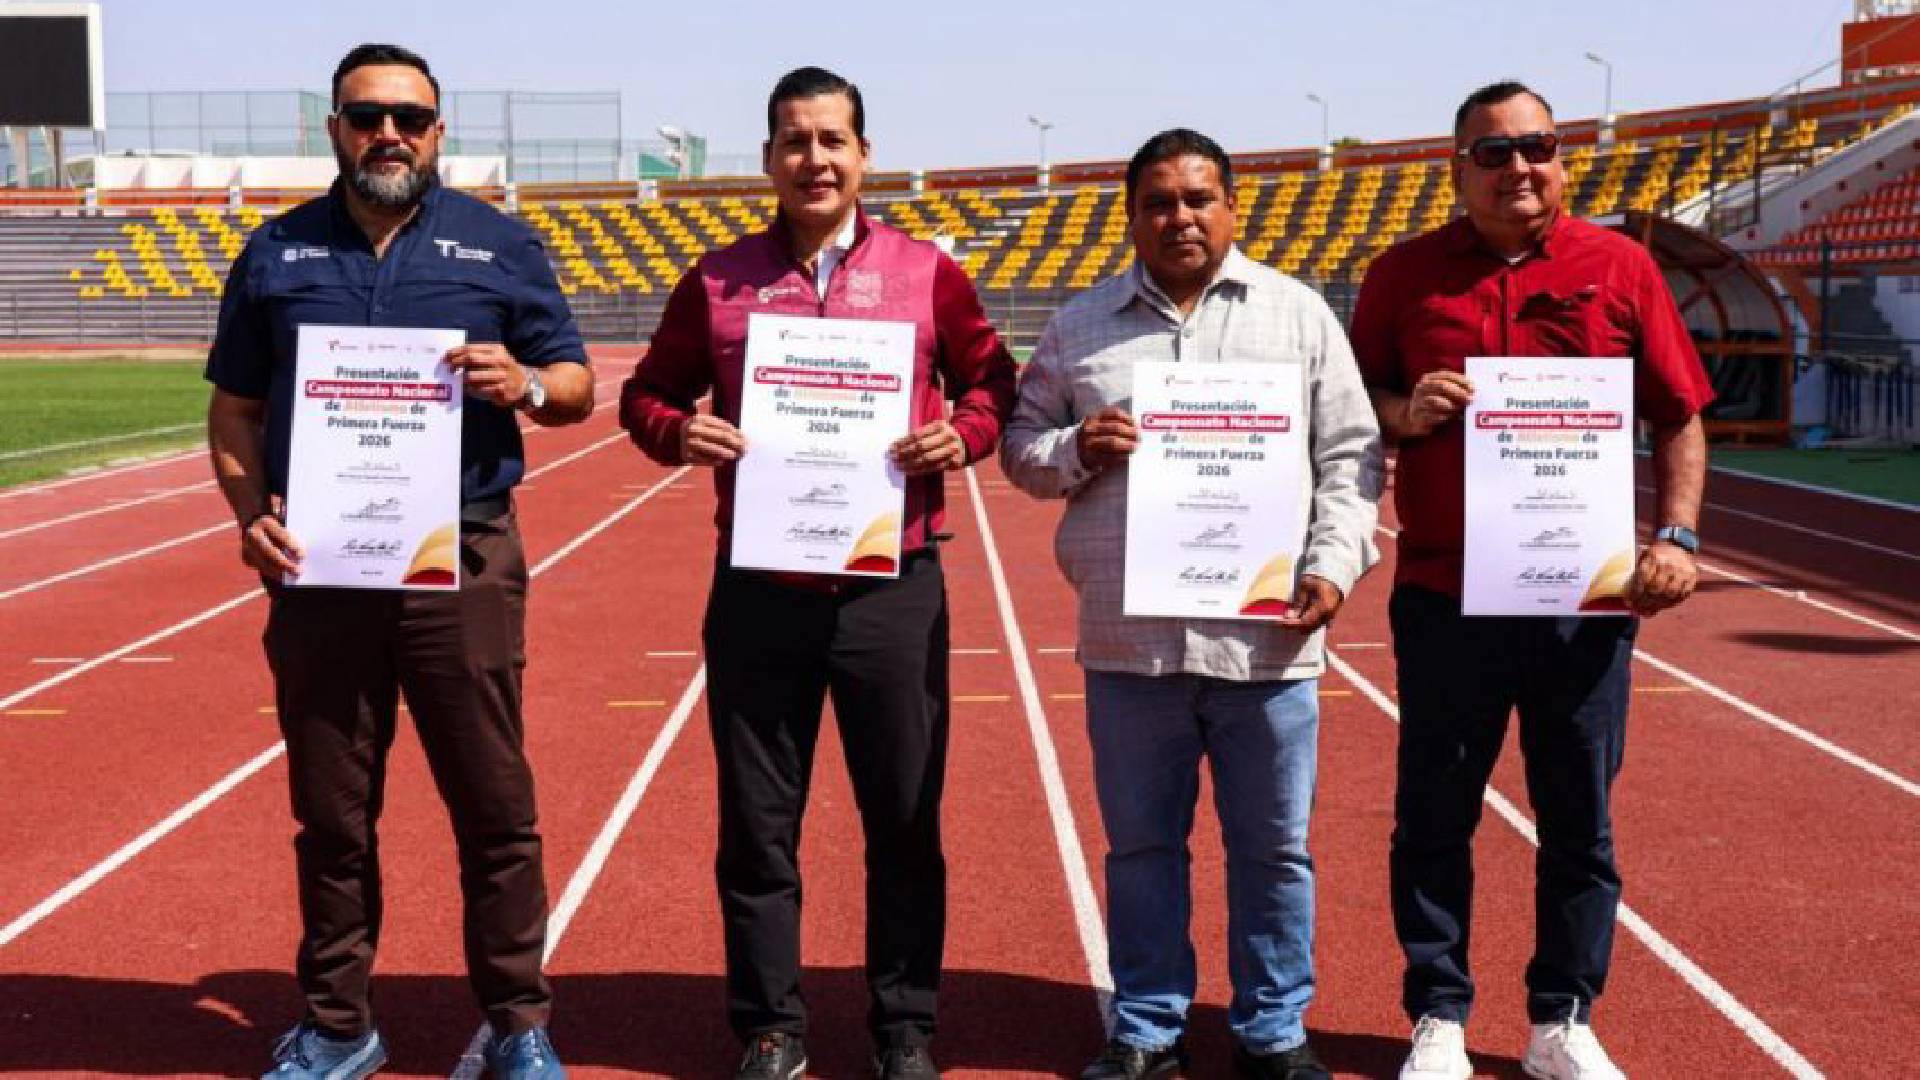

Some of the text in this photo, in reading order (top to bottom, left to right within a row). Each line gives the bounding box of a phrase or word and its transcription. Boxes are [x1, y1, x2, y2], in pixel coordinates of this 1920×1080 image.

[785, 355, 871, 369] Presentación
[335, 366, 420, 380] Presentación
[758, 369, 897, 388] Campeonato Nacional
[310, 382, 449, 398] Campeonato Nacional
[774, 385, 791, 398] de
[860, 390, 876, 404] de
[324, 400, 341, 412] de
[410, 402, 427, 414] de
[1171, 400, 1257, 412] Presentación
[1505, 397, 1590, 409] Presentación
[776, 402, 875, 420] Primera Fuerza
[327, 416, 426, 432] Primera Fuerza
[807, 420, 840, 434] 2026
[1145, 416, 1287, 431] Campeonato Nacional
[1479, 413, 1619, 430] Campeonato Nacional
[358, 434, 391, 448] 2026
[1161, 431, 1178, 443] de
[1249, 432, 1265, 444] de
[1497, 431, 1513, 443] de
[1582, 431, 1599, 443] de
[1164, 448, 1265, 461] Primera Fuerza
[1501, 447, 1600, 460] Primera Fuerza
[1197, 463, 1231, 477] 2026
[1534, 463, 1567, 477] 2026
